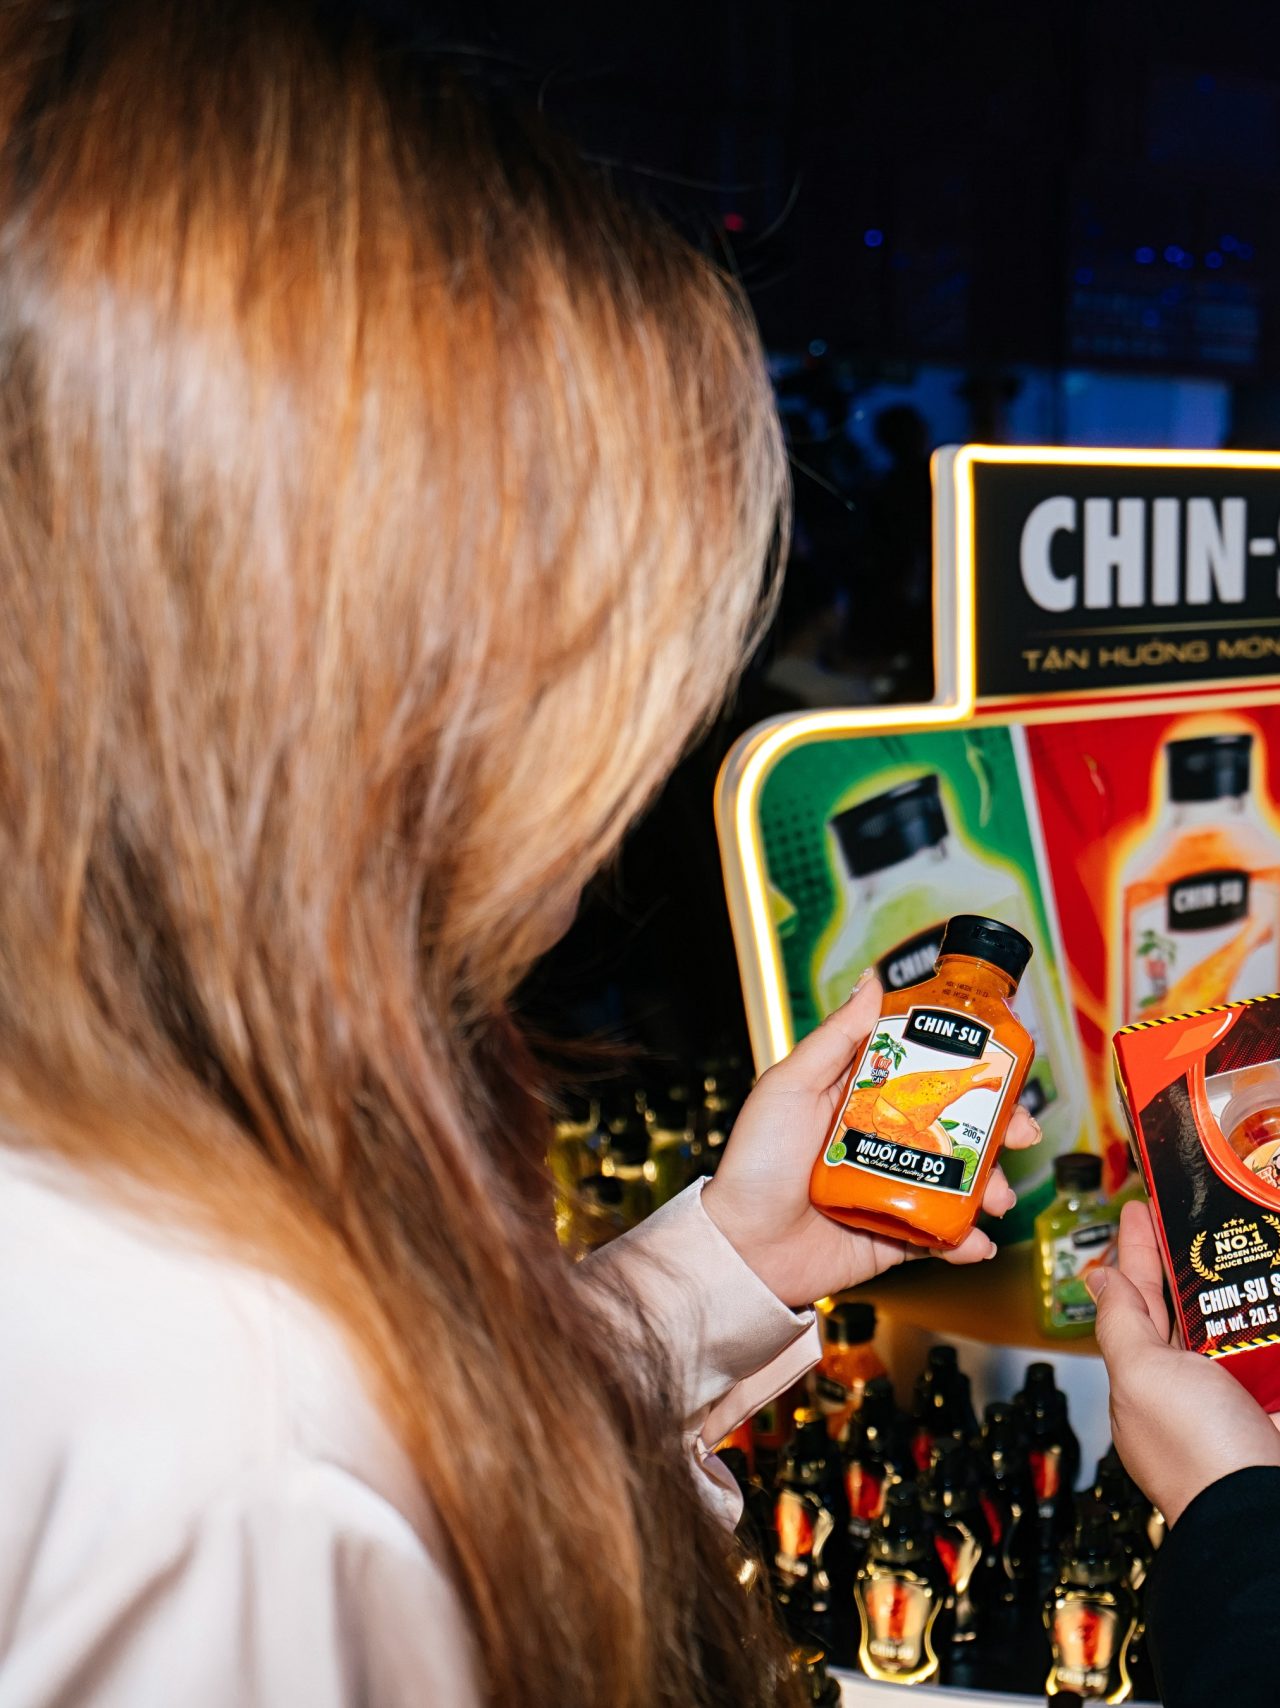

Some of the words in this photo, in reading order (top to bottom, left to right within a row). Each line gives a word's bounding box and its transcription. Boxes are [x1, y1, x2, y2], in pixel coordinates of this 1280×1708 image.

[888, 944, 940, 987] CHIN
[914, 1015, 982, 1046] CHIN-SU
[922, 1157, 946, 1175] ĐỎ
[1213, 1222, 1257, 1240] VIETNAM
[1215, 1230, 1263, 1255] NO.1
[1214, 1257, 1243, 1271] SAUCE
[1215, 1248, 1249, 1263] CHOSEN
[1250, 1243, 1268, 1254] HOT
[1198, 1276, 1270, 1316] CHIN-SU
[1205, 1317, 1228, 1338] Net
[1228, 1312, 1249, 1332] wt.
[1249, 1304, 1278, 1327] 20.5
